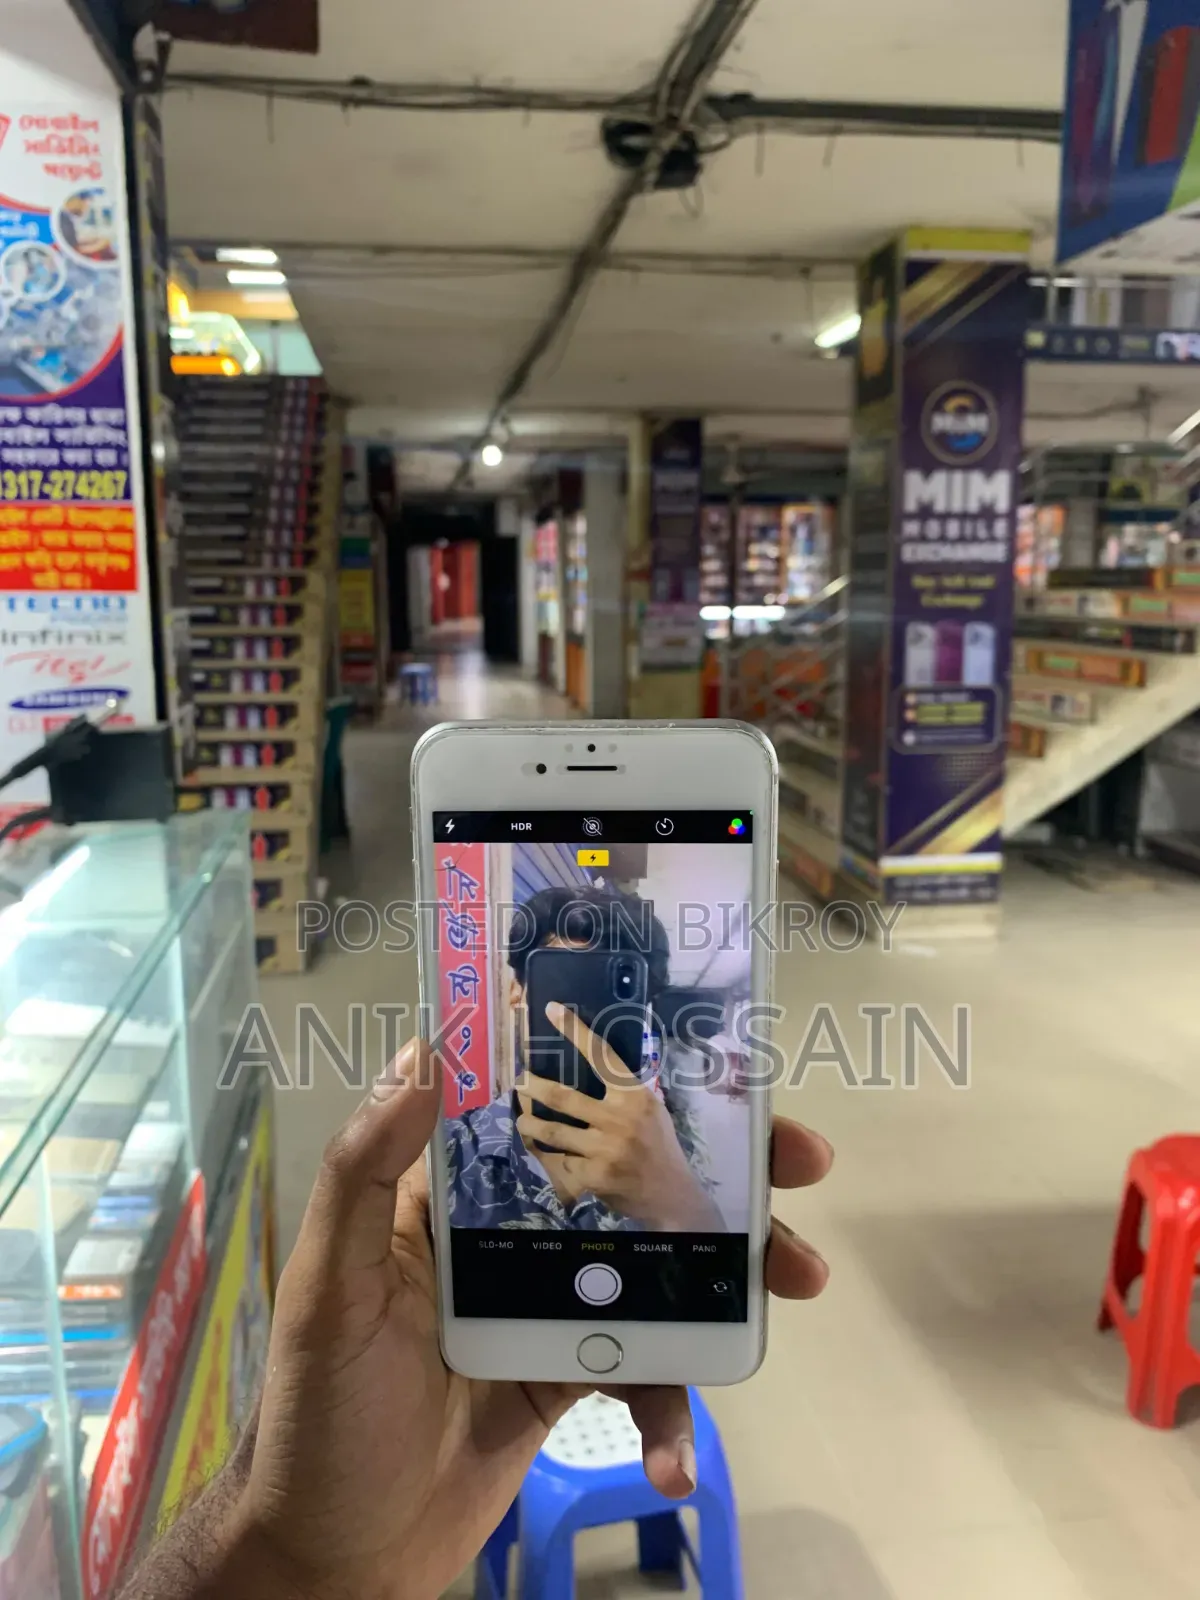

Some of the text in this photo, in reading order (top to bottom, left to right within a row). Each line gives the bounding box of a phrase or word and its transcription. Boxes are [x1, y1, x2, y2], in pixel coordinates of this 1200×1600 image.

[0, 469, 128, 499] 317-274267
[903, 469, 1010, 514] MIM
[902, 518, 1008, 539] MOBILE
[511, 822, 533, 832] HDR
[478, 1241, 717, 1252] SLO-MO VIDEO PHOTO SQUARE PANO
